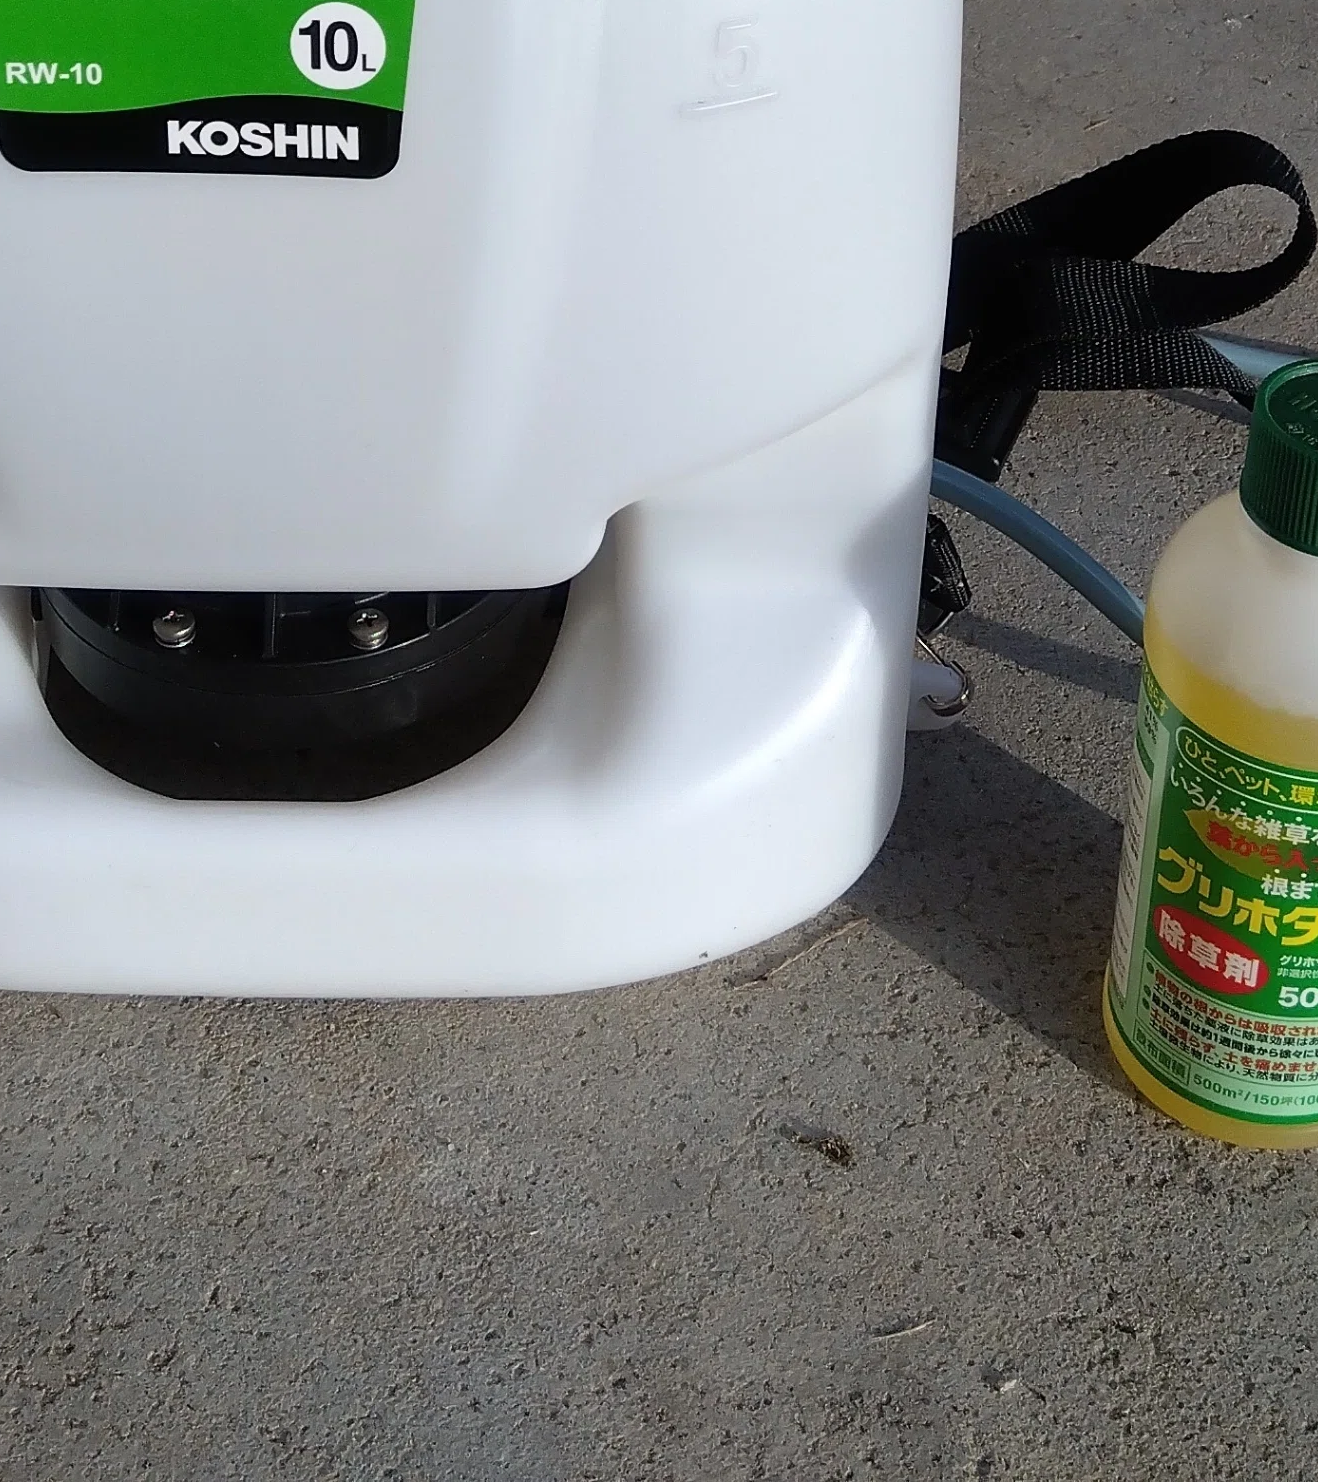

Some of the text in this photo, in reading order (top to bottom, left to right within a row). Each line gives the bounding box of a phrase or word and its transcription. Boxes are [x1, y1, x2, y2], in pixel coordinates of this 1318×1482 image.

[4, 61, 103, 86] RW-10
[165, 119, 360, 162] KOSHIN
[1157, 908, 1261, 989] 除草剤
